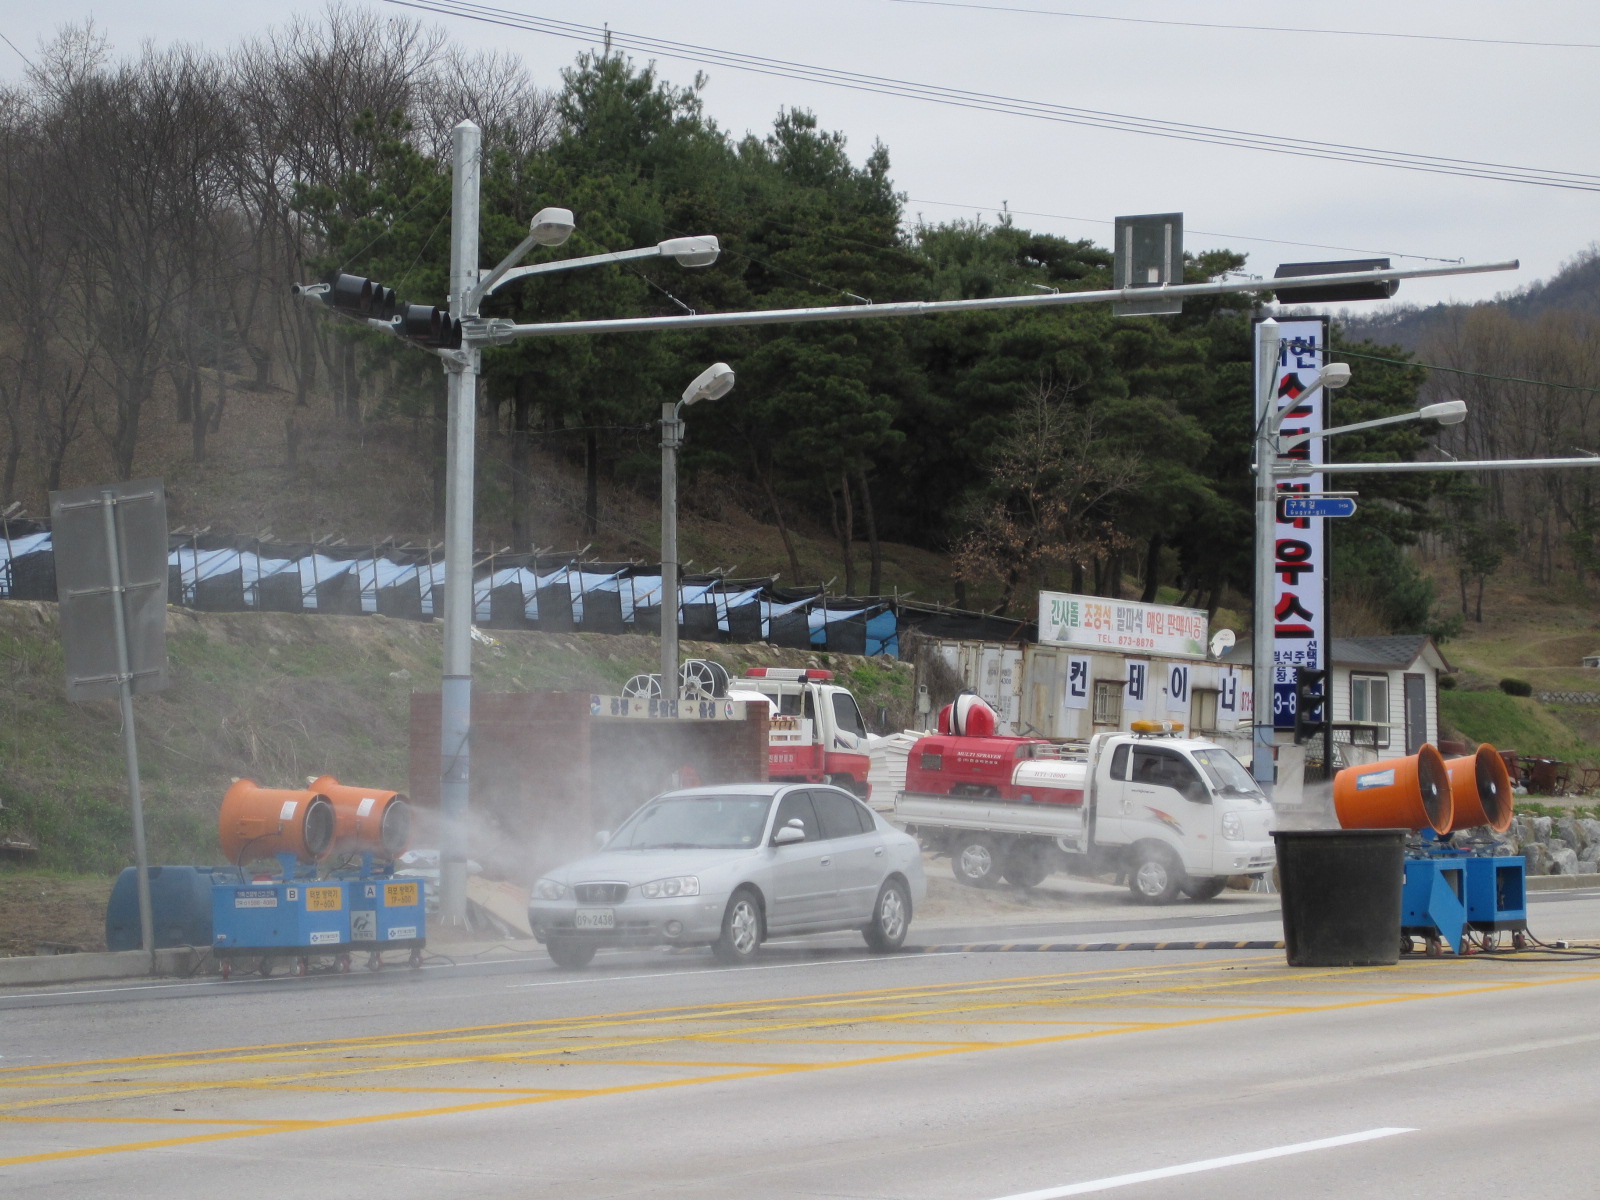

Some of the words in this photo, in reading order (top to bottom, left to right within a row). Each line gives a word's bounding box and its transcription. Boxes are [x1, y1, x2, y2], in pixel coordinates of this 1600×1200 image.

[1117, 606, 1144, 634] 발파석
[1146, 611, 1165, 635] 매입
[1097, 634, 1115, 644] TEL.
[975, 752, 1002, 760] SPRAYER
[289, 890, 296, 899] B
[367, 886, 375, 896] A
